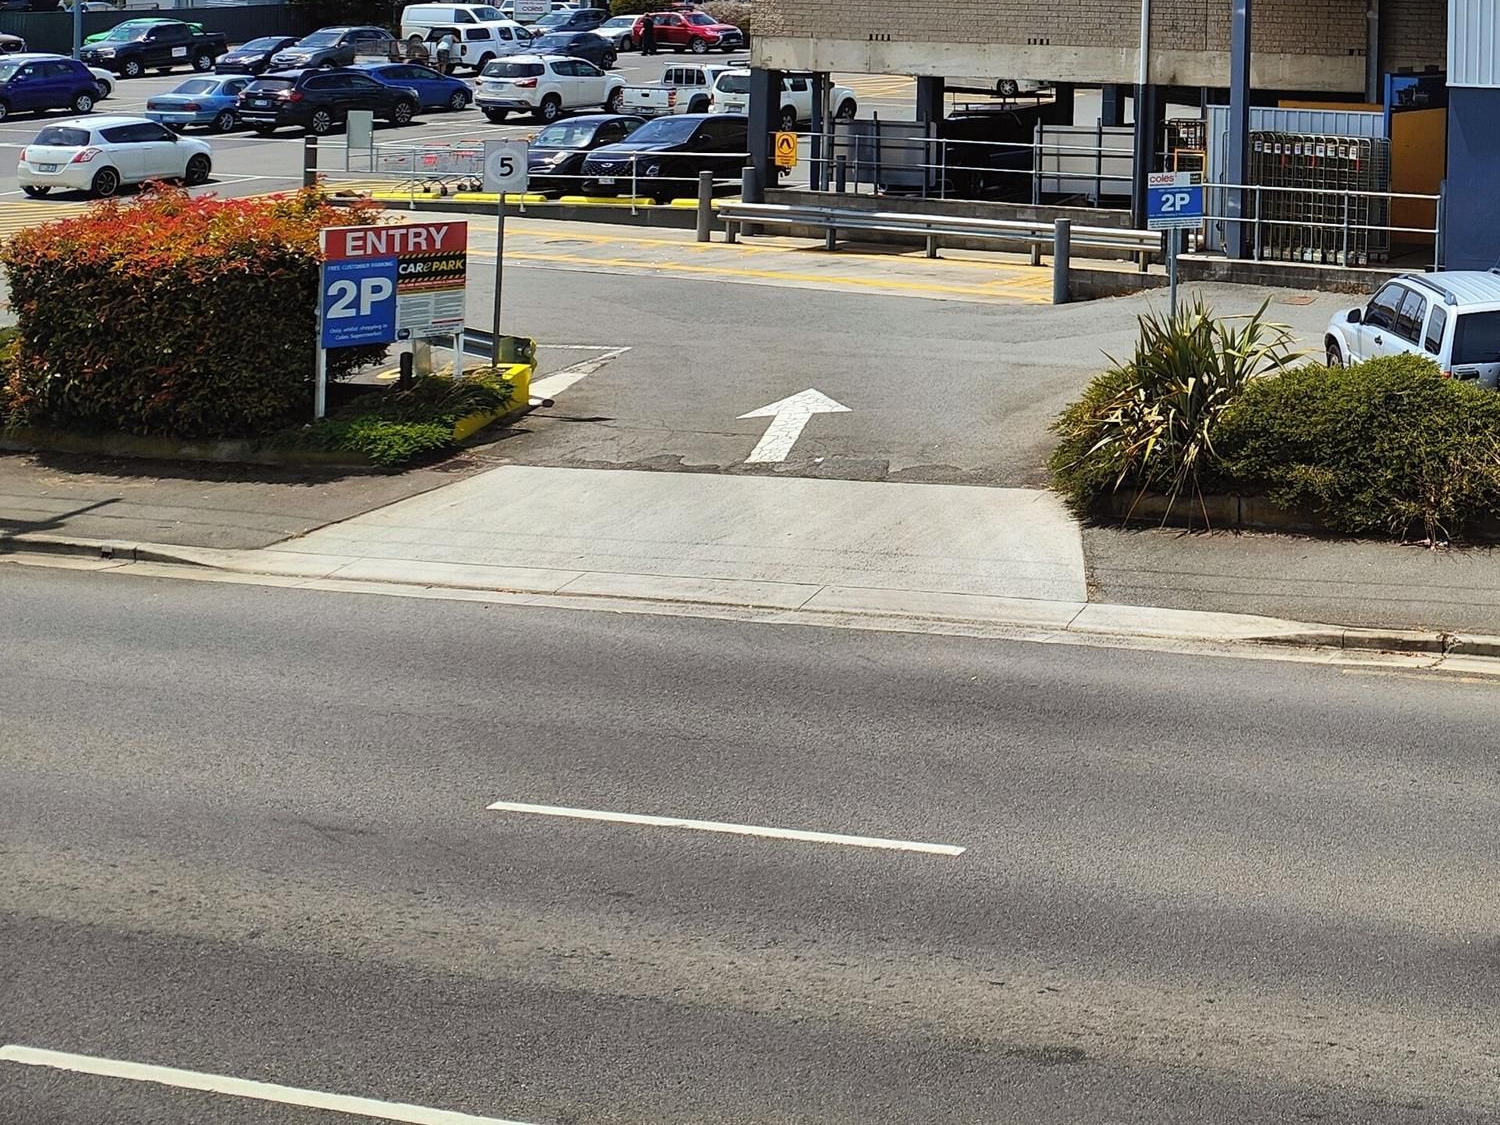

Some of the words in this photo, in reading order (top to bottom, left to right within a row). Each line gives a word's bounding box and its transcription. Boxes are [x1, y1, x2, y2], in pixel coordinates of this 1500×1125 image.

[499, 157, 513, 177] 5
[1150, 174, 1174, 183] coles
[1161, 193, 1190, 212] 2P
[345, 225, 448, 256] ENTRY
[326, 277, 393, 319] 2P
